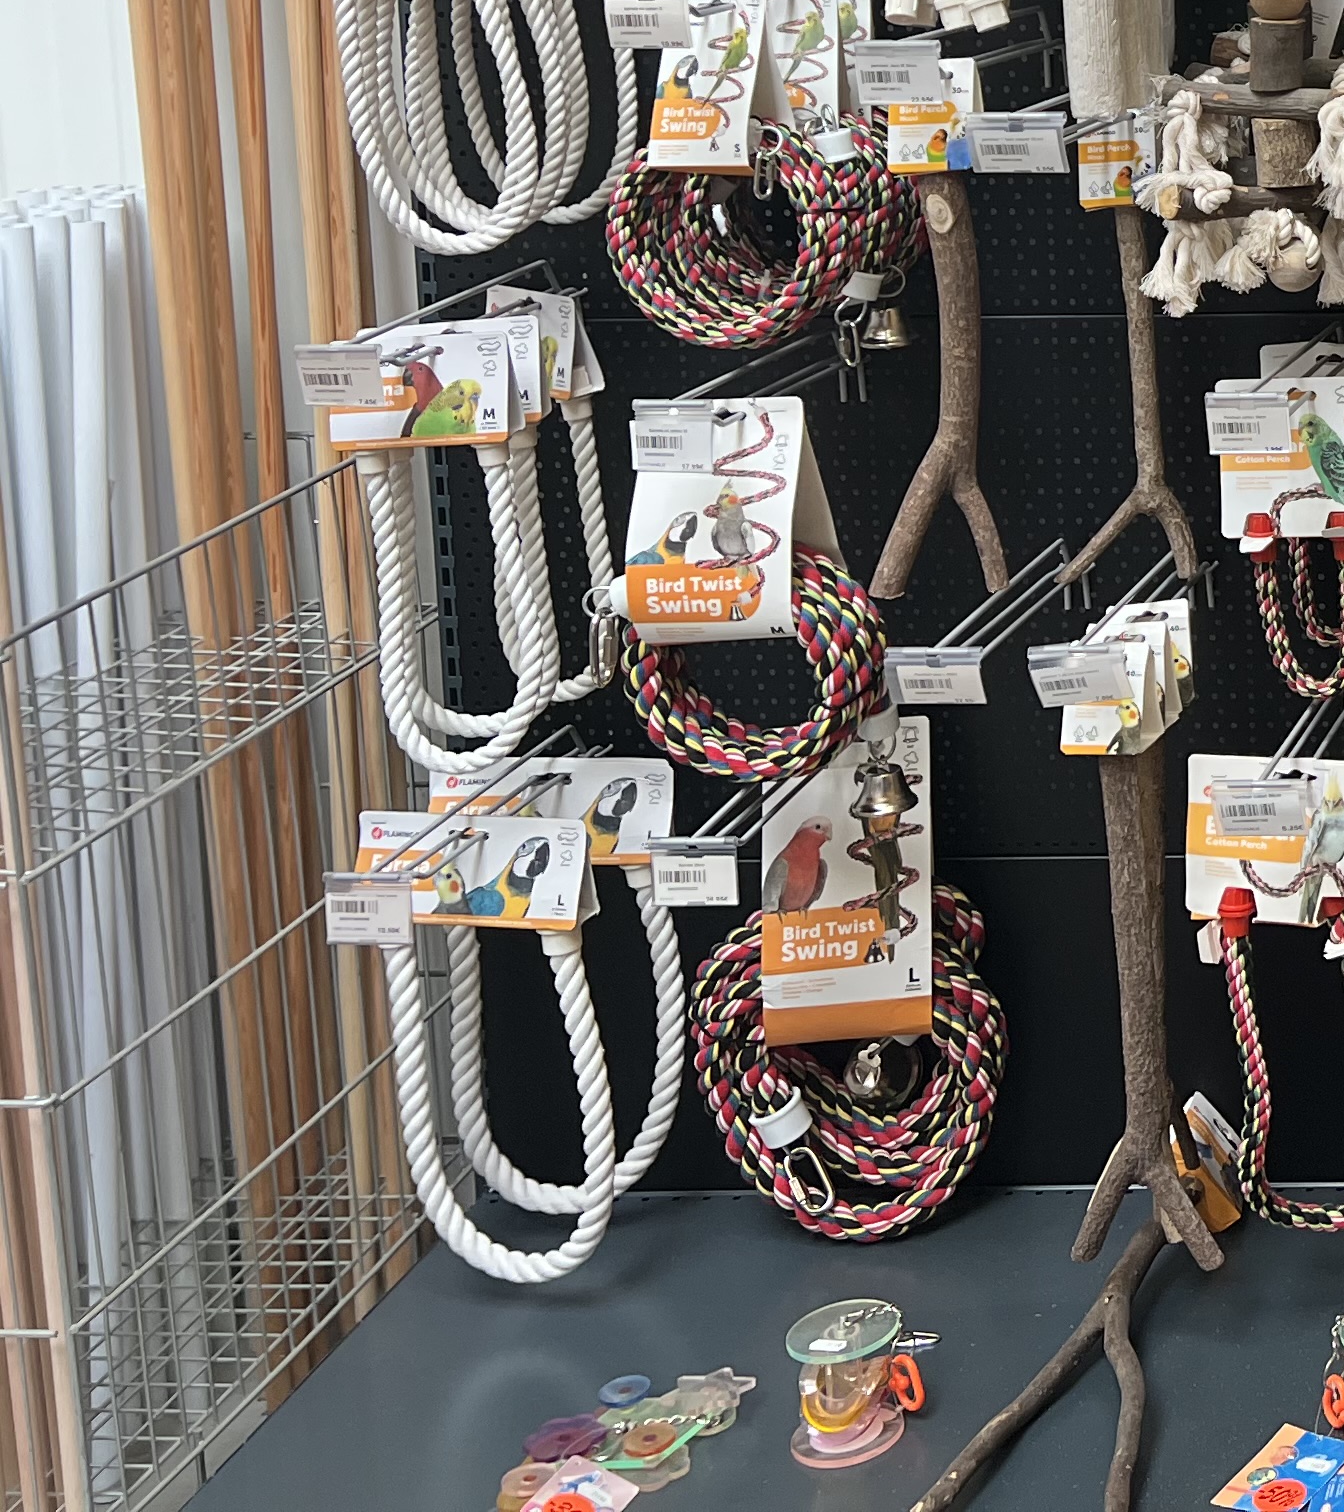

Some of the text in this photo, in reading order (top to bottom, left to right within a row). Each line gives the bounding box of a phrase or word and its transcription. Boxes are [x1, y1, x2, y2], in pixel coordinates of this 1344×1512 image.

[663, 106, 715, 118] Bird Twist
[858, 108, 864, 117] S
[899, 105, 918, 114] Bird
[659, 119, 707, 137] Swing
[734, 143, 740, 152] S
[557, 366, 565, 378] M
[483, 408, 495, 419] M
[1235, 454, 1290, 464] Cotton Perch
[646, 576, 742, 594] Bird Twist
[646, 597, 722, 616] Swing
[770, 626, 785, 635] M
[1205, 837, 1268, 850] Cotton Perch
[557, 894, 564, 906] L
[783, 918, 876, 941] Bird Twist
[781, 938, 859, 962] Swing
[908, 967, 920, 982] L
